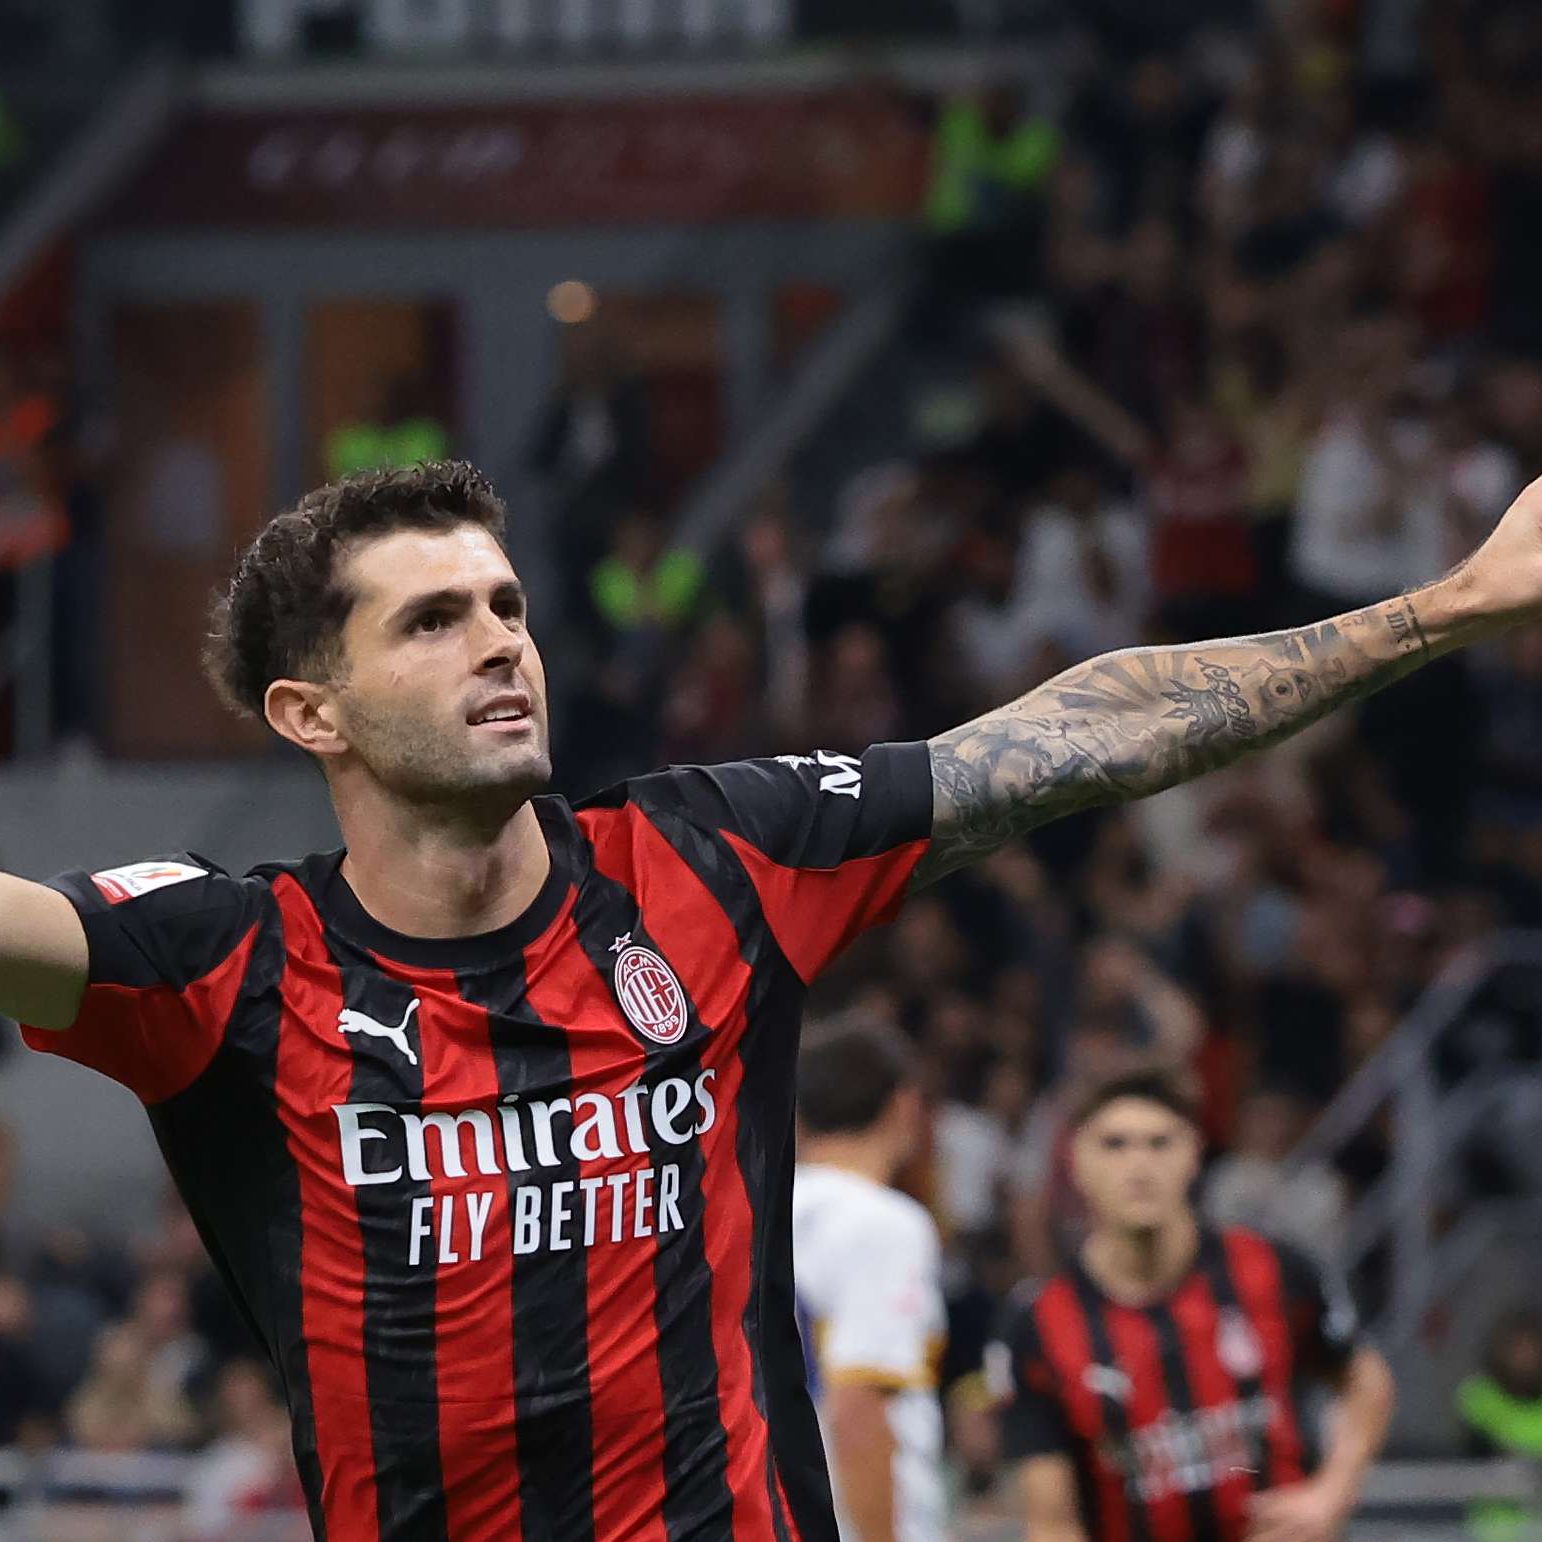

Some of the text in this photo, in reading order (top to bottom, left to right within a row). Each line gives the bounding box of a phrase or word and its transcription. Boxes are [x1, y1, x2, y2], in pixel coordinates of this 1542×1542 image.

[623, 955, 654, 982] ACM
[652, 1014, 680, 1034] 1899
[332, 1067, 717, 1186] Emirates
[408, 1162, 685, 1266] FLY BETTER
